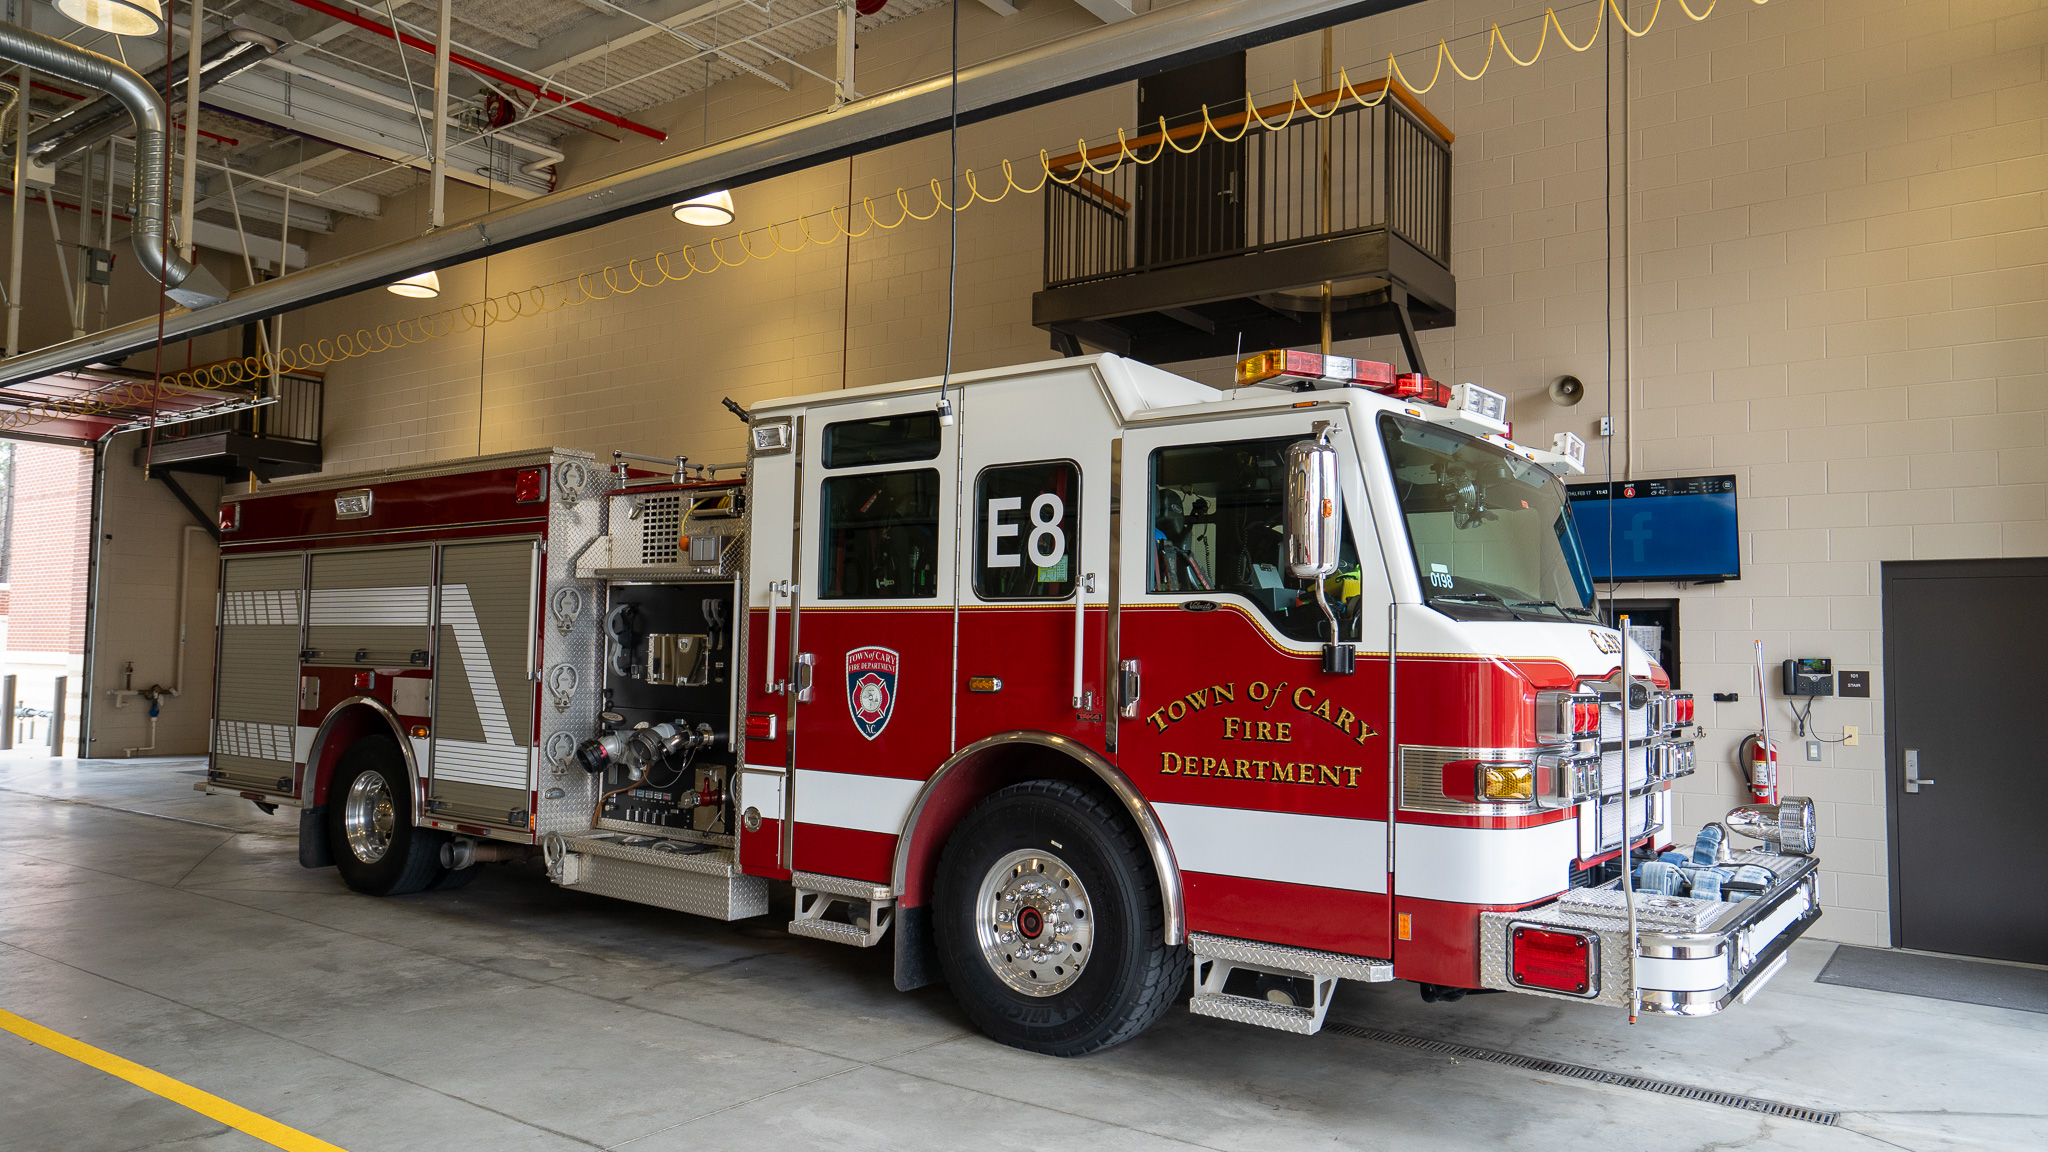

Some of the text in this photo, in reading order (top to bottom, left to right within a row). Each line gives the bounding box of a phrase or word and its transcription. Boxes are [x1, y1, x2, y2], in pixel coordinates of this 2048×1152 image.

[988, 493, 1065, 567] E8
[1430, 571, 1454, 589] 0198
[849, 652, 868, 663] TOWN
[876, 651, 895, 664] CARY
[849, 662, 895, 672] FIRE DEPARTMENT
[1147, 681, 1379, 745] TOWN Of CARY
[1223, 717, 1291, 742] FIRE
[1160, 752, 1362, 788] DEPARTMENT
